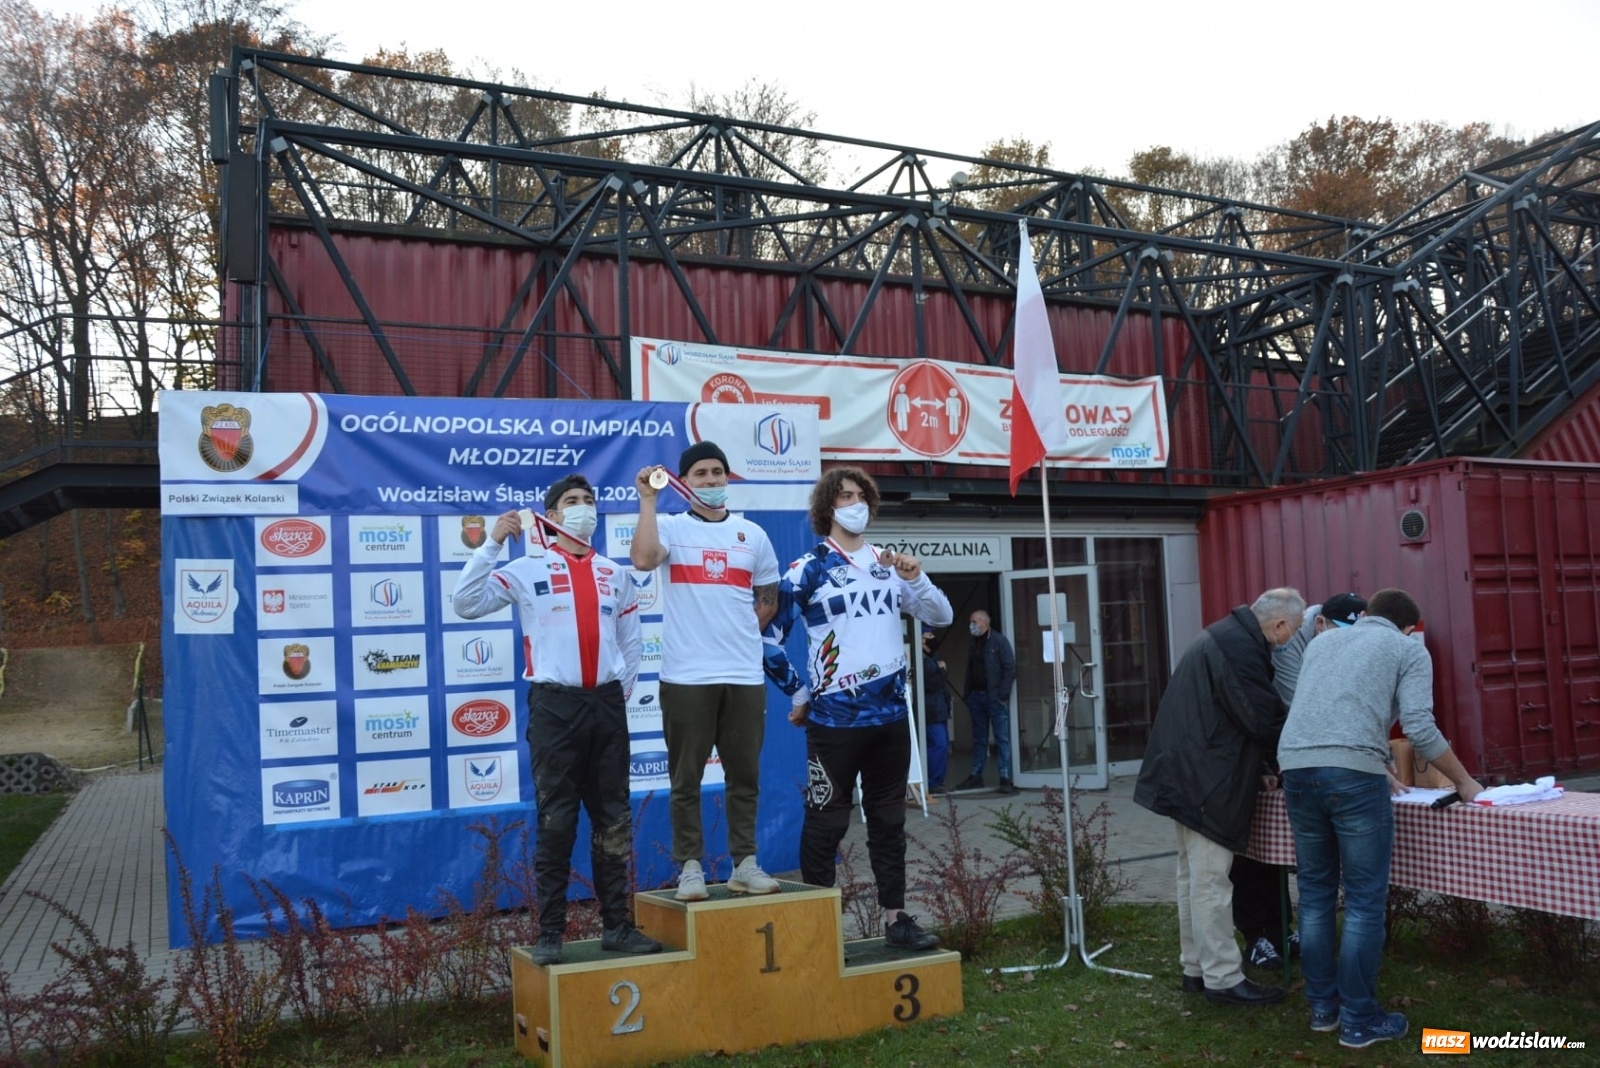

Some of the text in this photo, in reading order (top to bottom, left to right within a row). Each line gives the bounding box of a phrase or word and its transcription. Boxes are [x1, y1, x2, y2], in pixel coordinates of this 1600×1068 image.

[709, 375, 746, 392] KORONA
[340, 411, 675, 437] OGÓLNOPOLSKA OLIMPIADA
[920, 411, 939, 428] 2m
[448, 443, 586, 466] MŁODZIEŻY
[1111, 446, 1152, 458] mosir
[746, 457, 811, 468] WODZISŁAW ŚLĄSKI
[168, 492, 285, 506] Polski Związek Kolarski
[377, 483, 642, 506] Wodzisław Śląsk 1.202
[269, 527, 313, 542] skawa
[359, 529, 412, 543] mosir
[365, 543, 405, 551] centrum
[703, 550, 726, 558] POLSKA
[869, 539, 991, 557] OŻYCZALNIA
[635, 593, 655, 601] UILA
[186, 600, 222, 610] AQUILA
[392, 654, 421, 662] TEAM
[640, 654, 662, 662] trum
[459, 707, 499, 723] skawa
[365, 714, 420, 731] mosir
[266, 726, 331, 737] Timemaster
[372, 730, 412, 740] centrum
[470, 782, 499, 791] AQUILA
[274, 787, 328, 805] KAPRIN
[755, 921, 782, 974] 1
[893, 973, 921, 1023] 3
[608, 979, 644, 1035] 2
